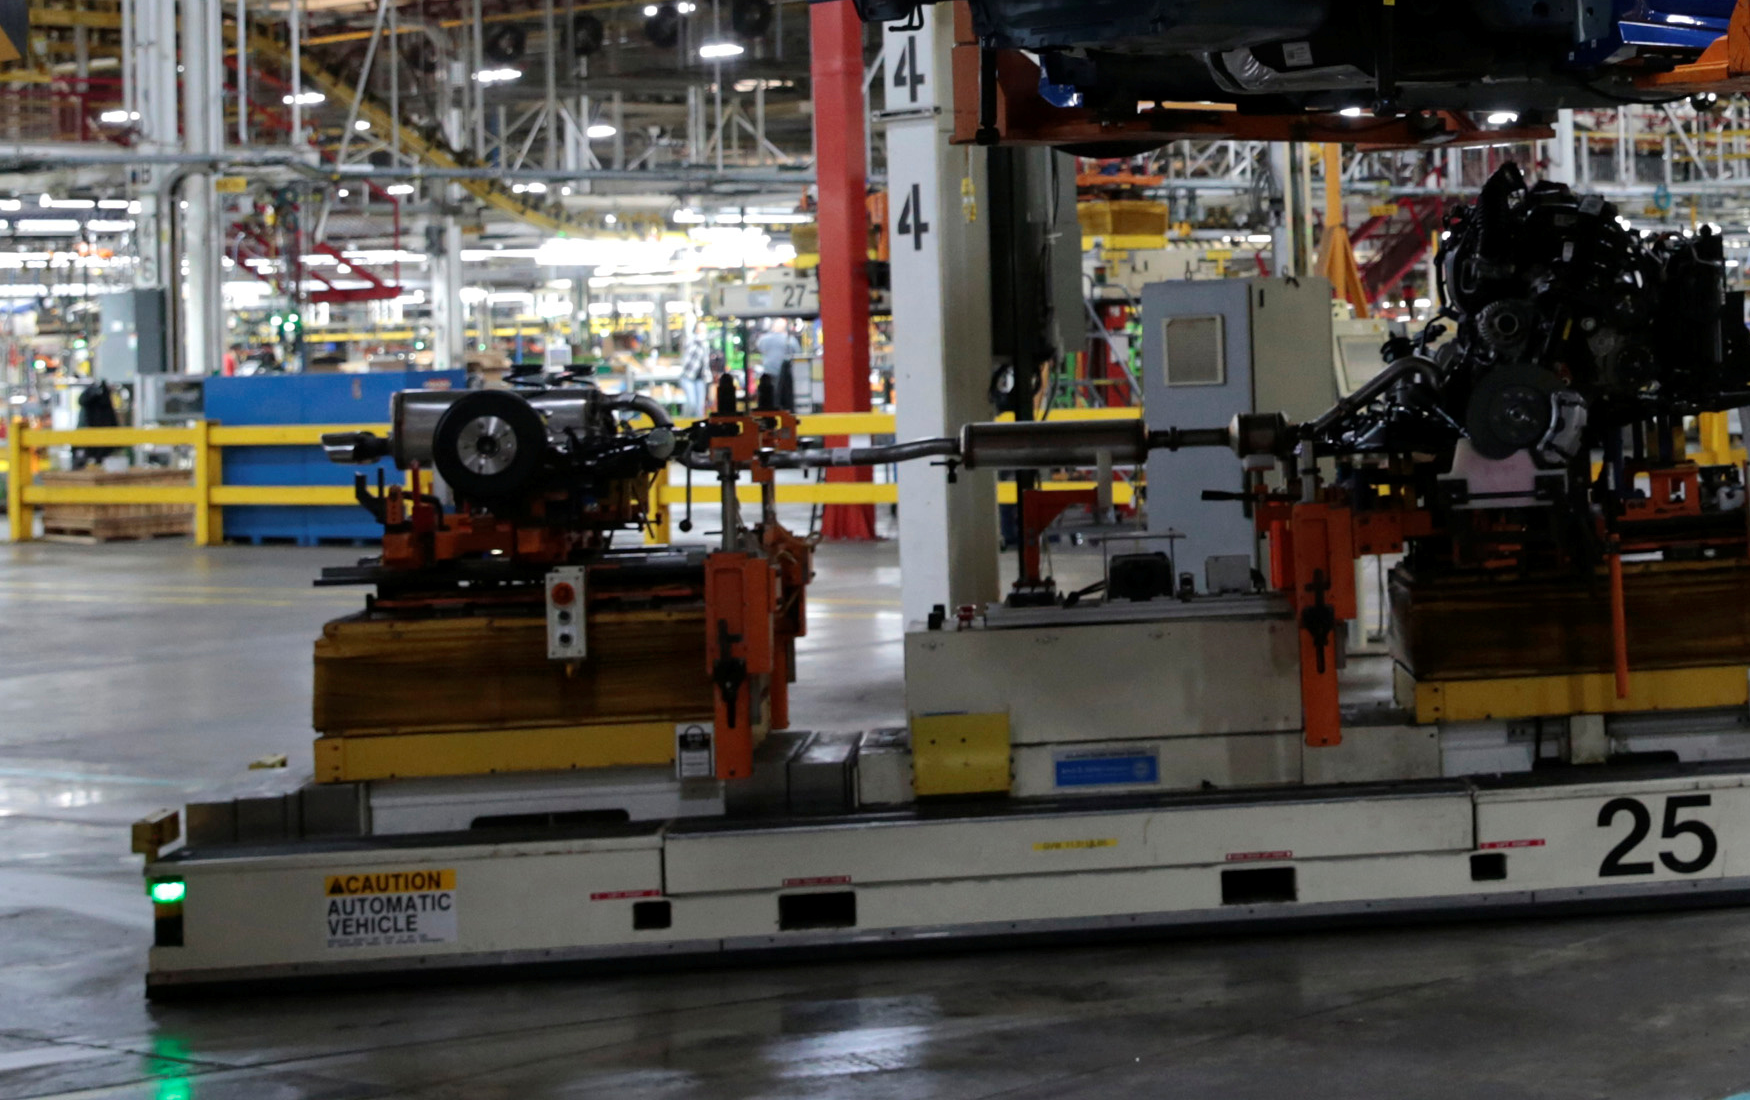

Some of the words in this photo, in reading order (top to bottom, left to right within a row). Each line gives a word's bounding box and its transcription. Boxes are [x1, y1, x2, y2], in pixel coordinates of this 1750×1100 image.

[893, 35, 925, 102] 4
[898, 183, 929, 251] 4
[783, 284, 806, 308] 27
[1597, 794, 1718, 878] 25
[345, 871, 442, 894] CAUTION
[328, 893, 452, 917] AUTOMATIC
[328, 914, 418, 936] VEHICLE
